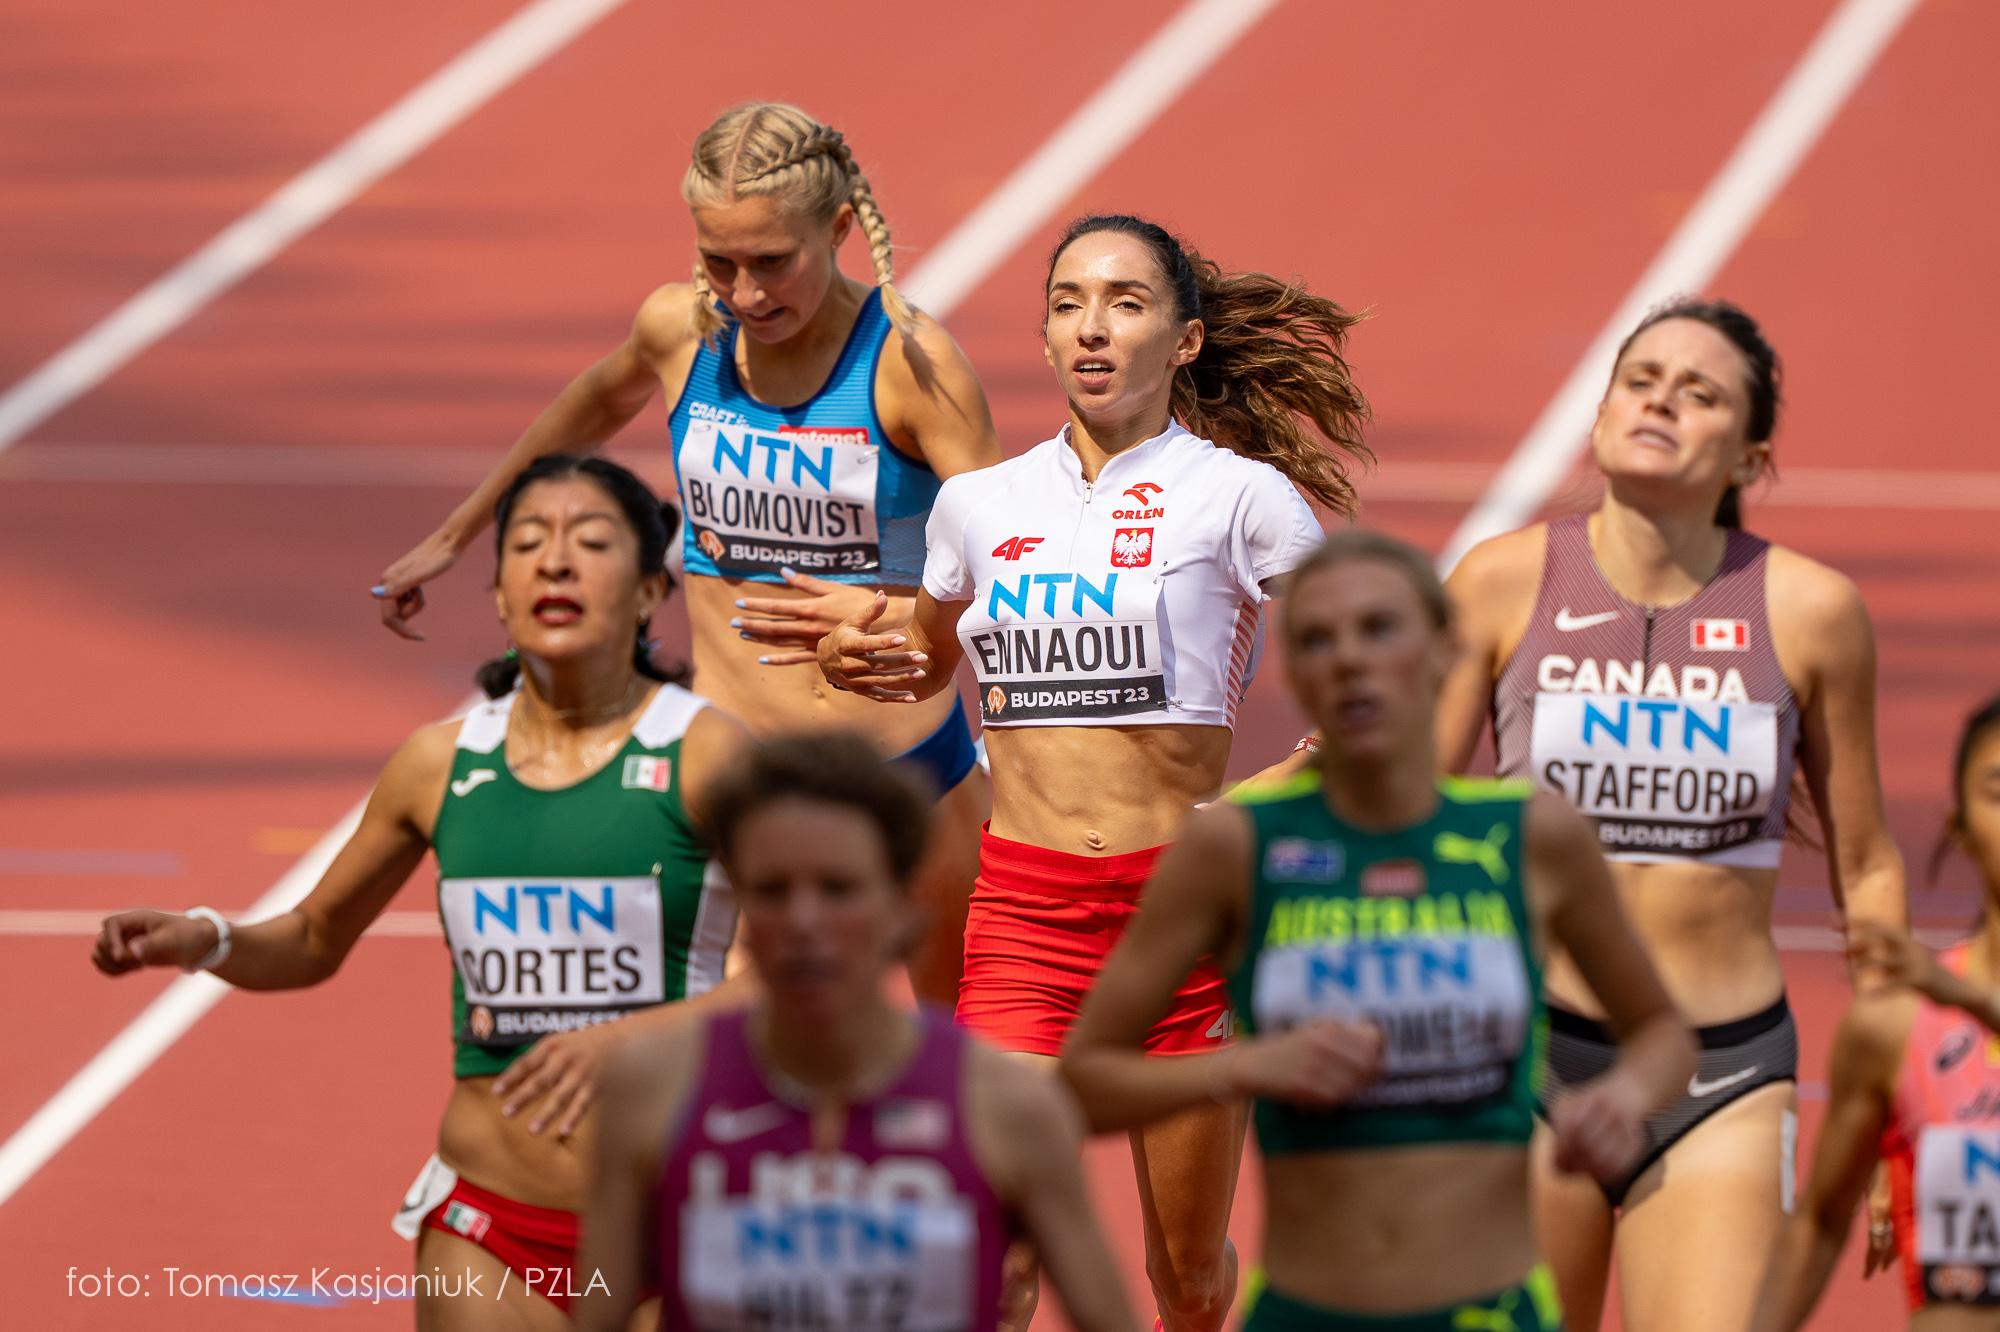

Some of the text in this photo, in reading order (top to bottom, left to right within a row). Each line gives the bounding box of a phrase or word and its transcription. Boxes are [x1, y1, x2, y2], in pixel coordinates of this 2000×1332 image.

[688, 401, 736, 424] CRAFT
[713, 430, 833, 492] NTN
[689, 478, 864, 541] BLOMQVIST
[1112, 507, 1164, 520] ORLEN
[730, 543, 866, 567] BUDAPEST 23
[992, 536, 1045, 561] 4F
[988, 573, 1118, 622] NTN
[970, 625, 1147, 675] ENNAOUI
[1010, 686, 1150, 708] BUDAPEST 23
[1537, 654, 1750, 704] CANADA
[1582, 701, 1730, 756] NTN
[1544, 760, 1758, 815] STAFFORD
[1599, 822, 1723, 849] BUDAPEST
[473, 885, 615, 935] NTN
[1306, 939, 1475, 1002] NTN
[737, 1203, 917, 1267] NTN
